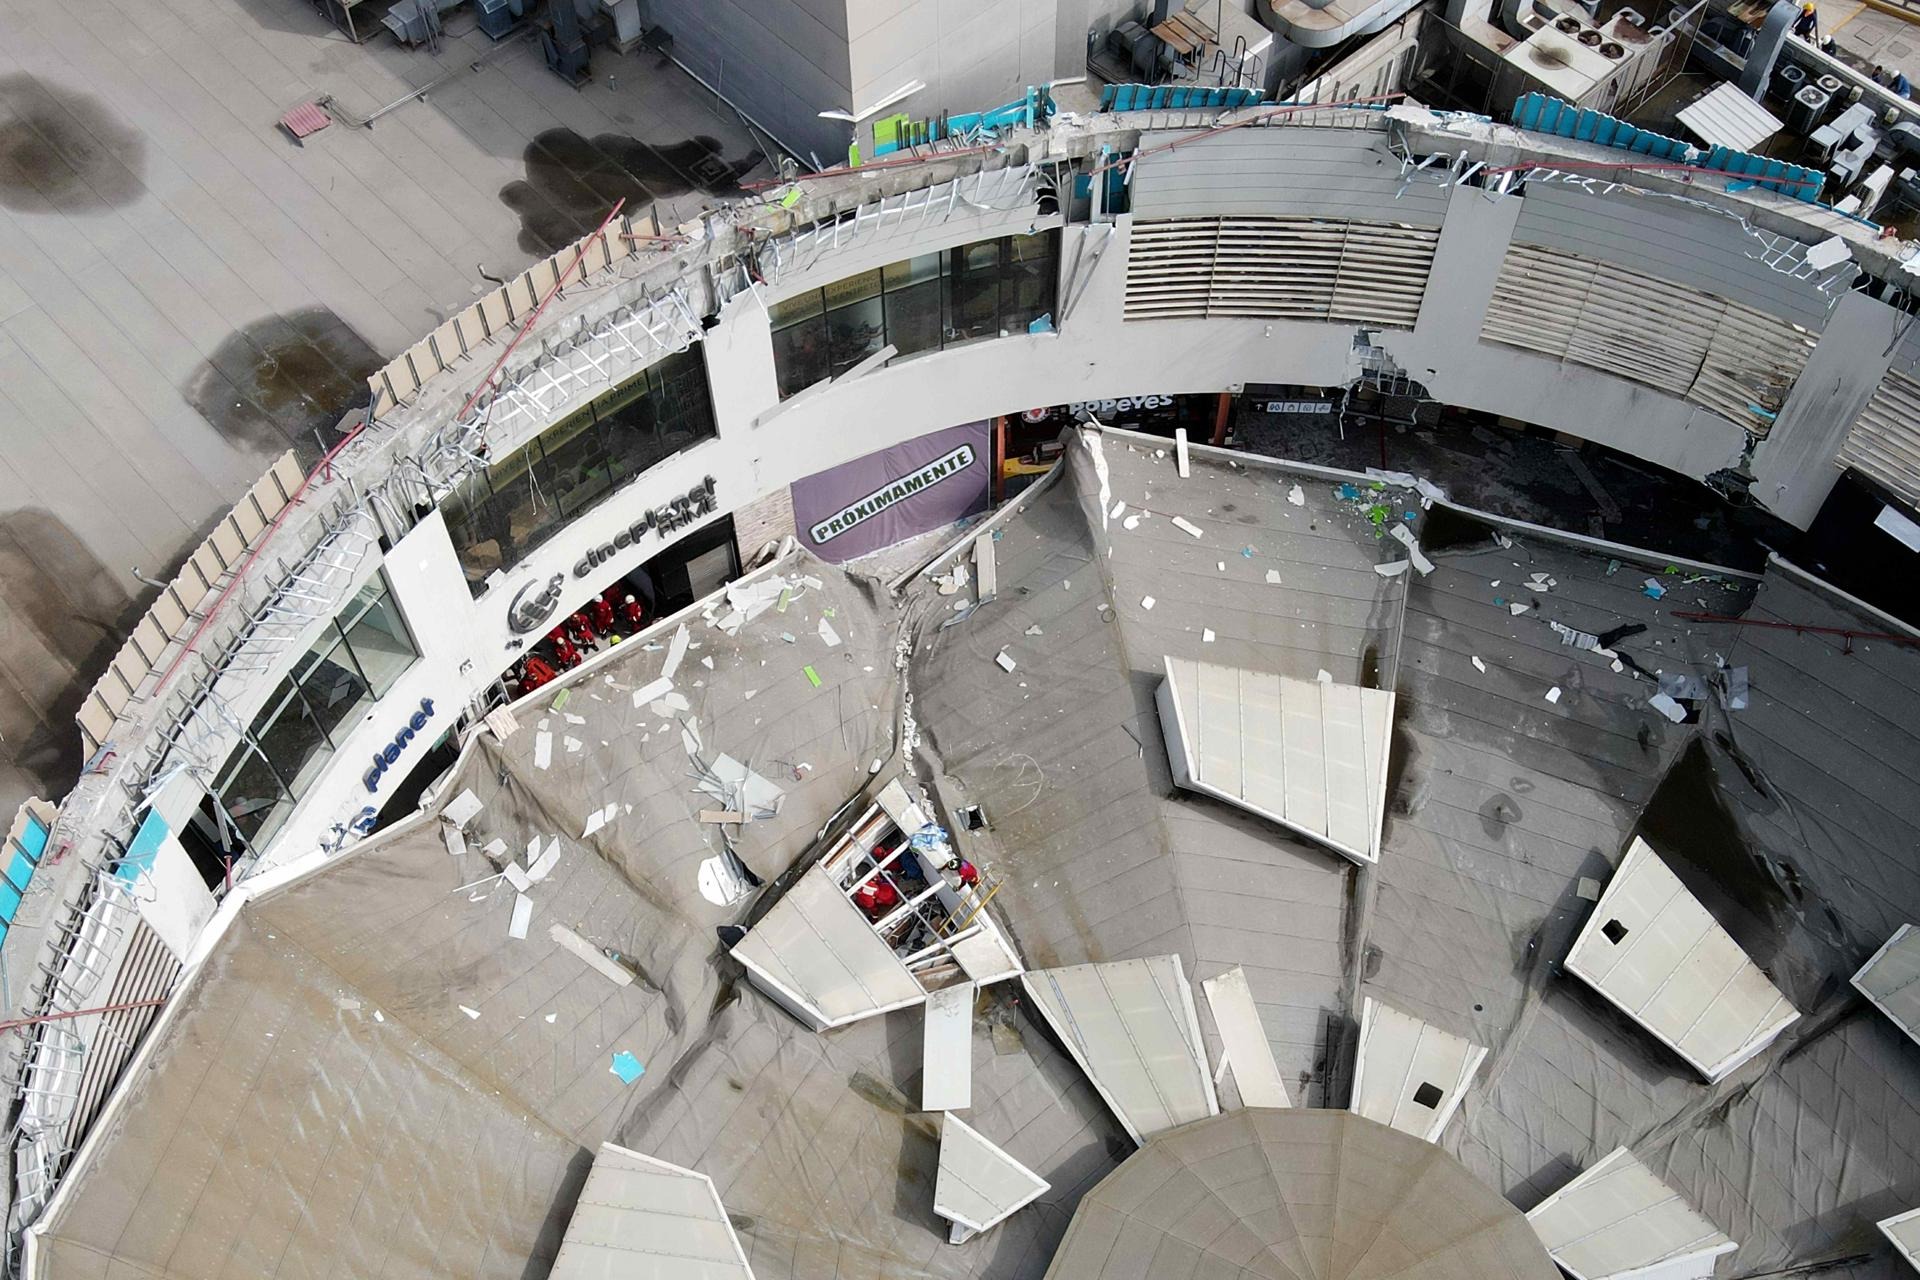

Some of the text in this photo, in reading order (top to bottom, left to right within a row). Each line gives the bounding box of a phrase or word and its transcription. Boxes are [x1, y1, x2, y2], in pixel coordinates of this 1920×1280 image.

[573, 474, 718, 579] cineplanet
[657, 494, 719, 540] PRIME
[816, 450, 970, 541] PRÓXIMAMENTE
